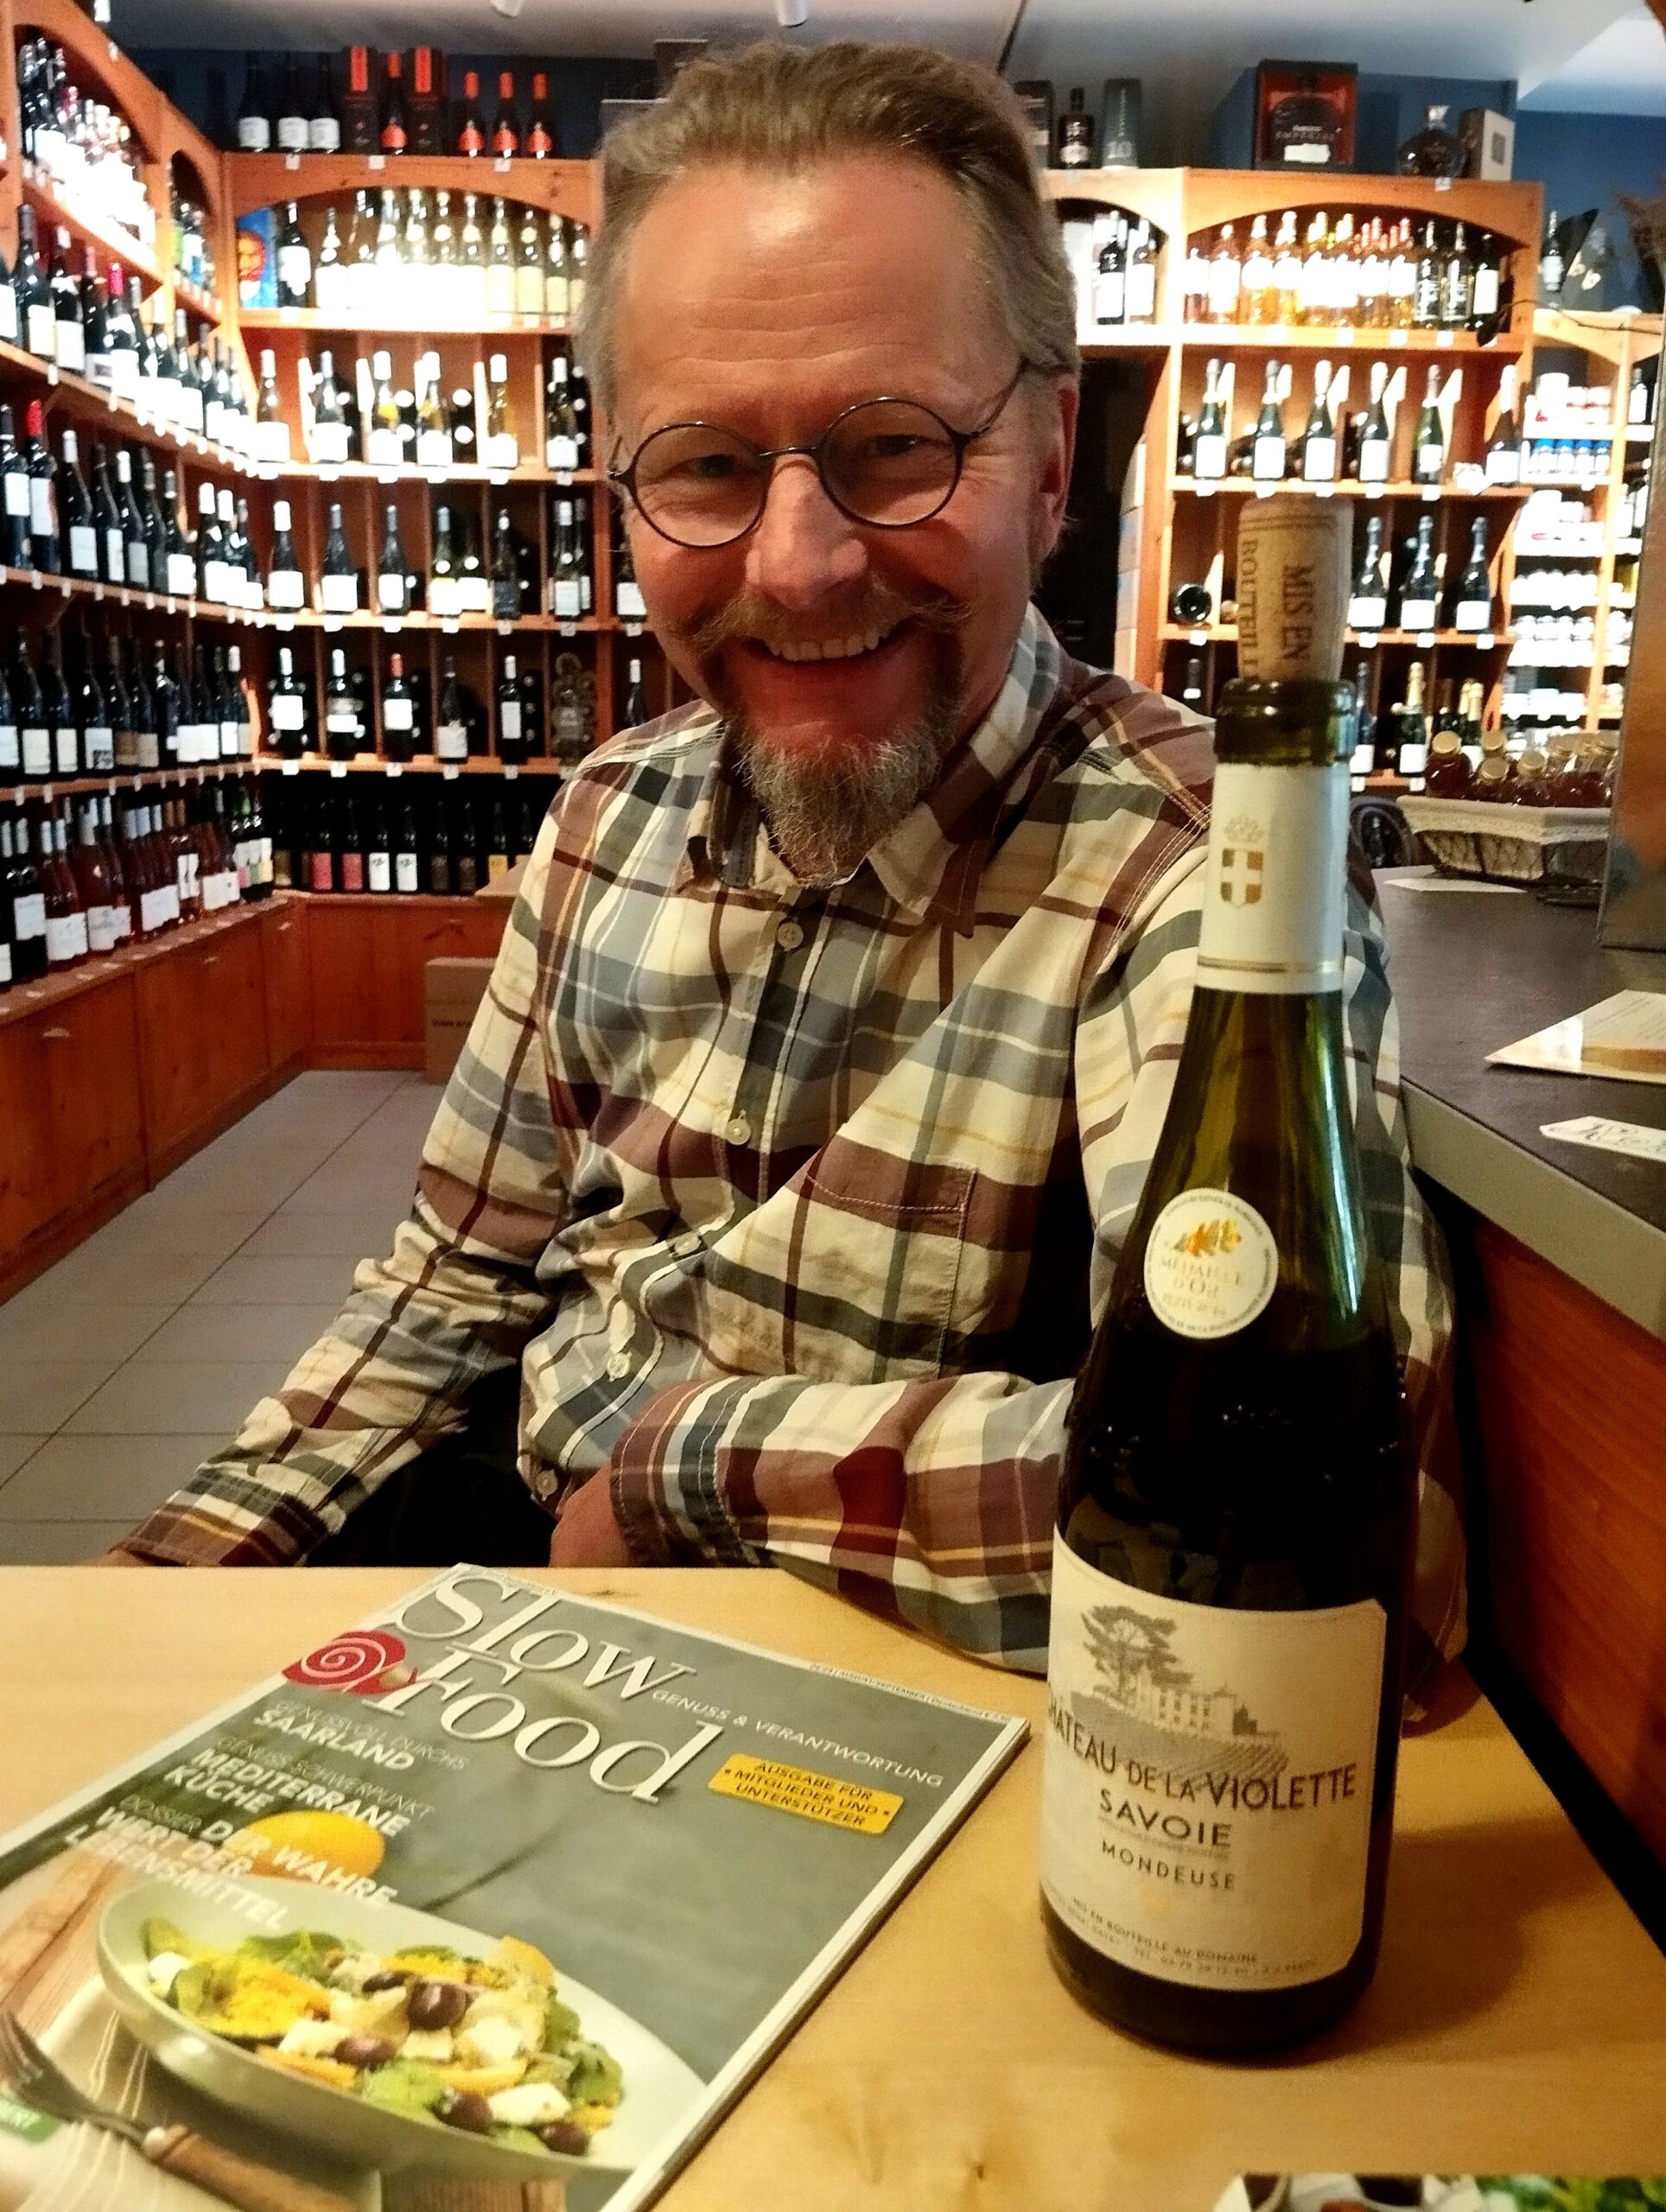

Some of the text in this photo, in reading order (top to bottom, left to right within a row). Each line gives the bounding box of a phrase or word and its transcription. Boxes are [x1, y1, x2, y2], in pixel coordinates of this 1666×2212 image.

[1280, 565, 1315, 661] MIS EN
[396, 1575, 696, 1700] Slow
[253, 1708, 416, 1770] SAARLAND
[361, 1642, 724, 1805] Food
[652, 1689, 945, 1788] GENUSS & VERANTWORTUNG
[163, 1764, 276, 1815] KÜCHE
[190, 1747, 411, 1837] MEDITERRANE
[734, 1770, 879, 1815] MITGLIEDER UND
[735, 1783, 866, 1826] UNTERSTÜTZER
[754, 1762, 874, 1801] AUSGABE FÜR
[1128, 1759, 1157, 1793] DE
[1166, 1771, 1196, 1802] LA
[1205, 1763, 1358, 1811] VIOLETTE
[95, 1806, 254, 1877] WERT DER
[1099, 1788, 1232, 1848] SAVOIE
[199, 1818, 273, 1859] DER
[271, 1846, 399, 1906] WAHRE
[1102, 1839, 1235, 1891] MONDEUSE
